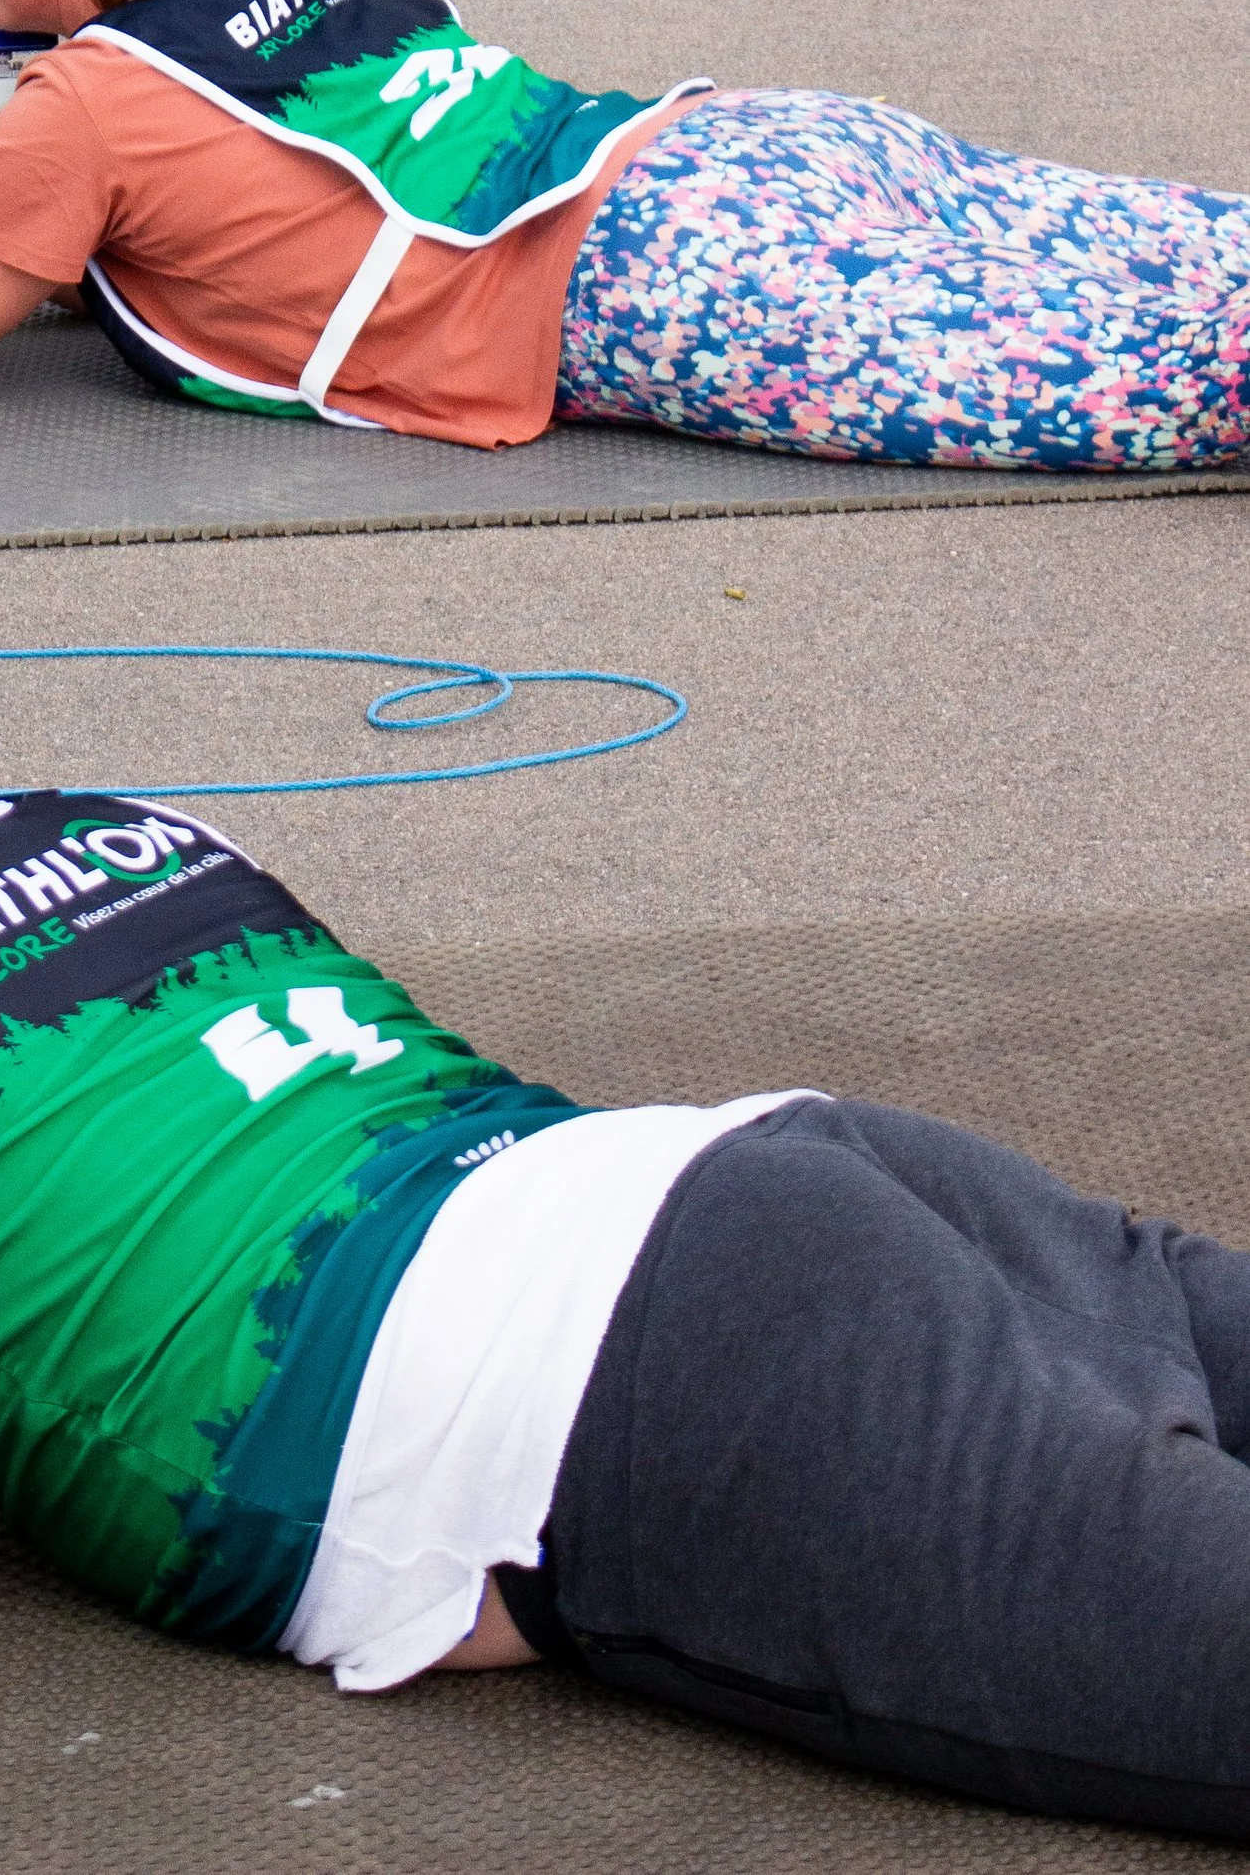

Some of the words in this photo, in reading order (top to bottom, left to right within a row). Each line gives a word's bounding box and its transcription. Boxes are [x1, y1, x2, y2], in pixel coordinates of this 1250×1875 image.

[256, 0, 328, 61] XPLORE
[72, 903, 117, 929] Visez
[113, 895, 134, 911] au
[167, 870, 189, 886] de
[181, 860, 205, 876] la
[199, 986, 404, 1101] 4
